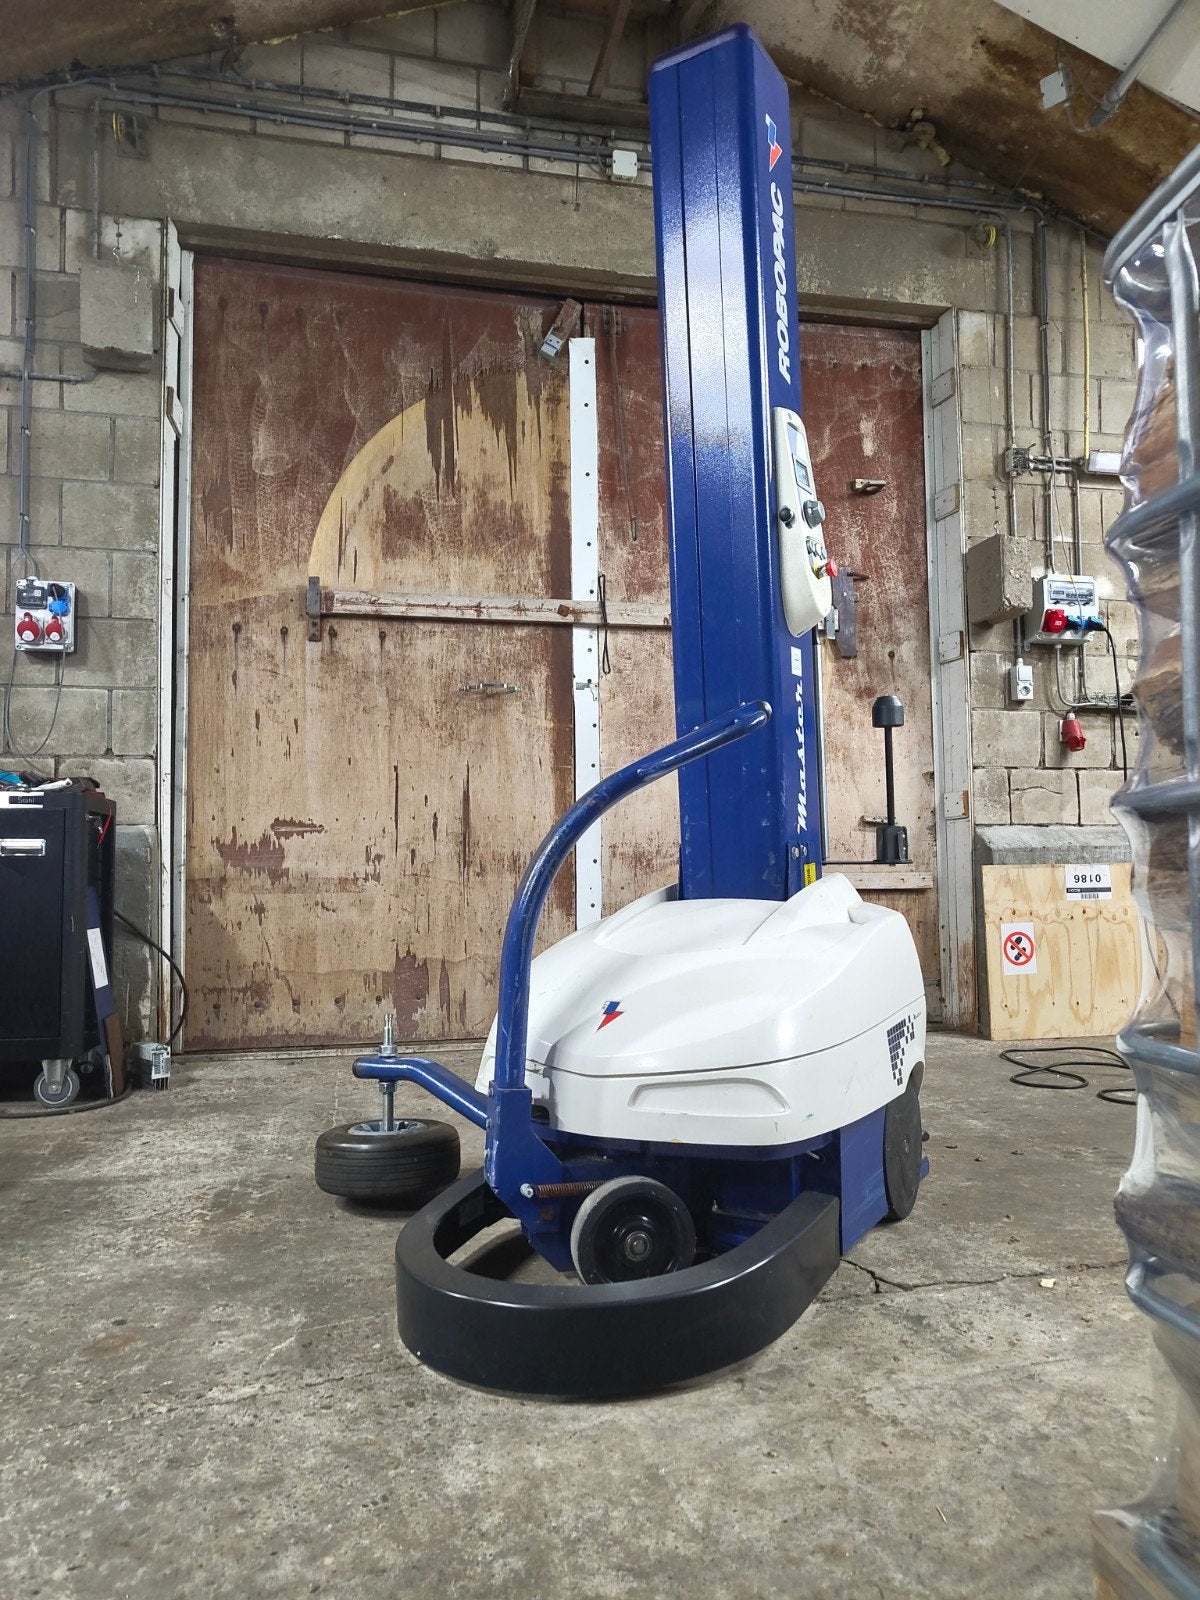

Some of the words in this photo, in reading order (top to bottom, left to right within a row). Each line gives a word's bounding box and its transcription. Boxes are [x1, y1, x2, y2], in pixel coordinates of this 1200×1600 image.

[770, 181, 792, 386] ROBOPAC
[796, 680, 808, 834] Master
[17, 796, 35, 804] Stahl
[1073, 874, 1101, 883] 0186
